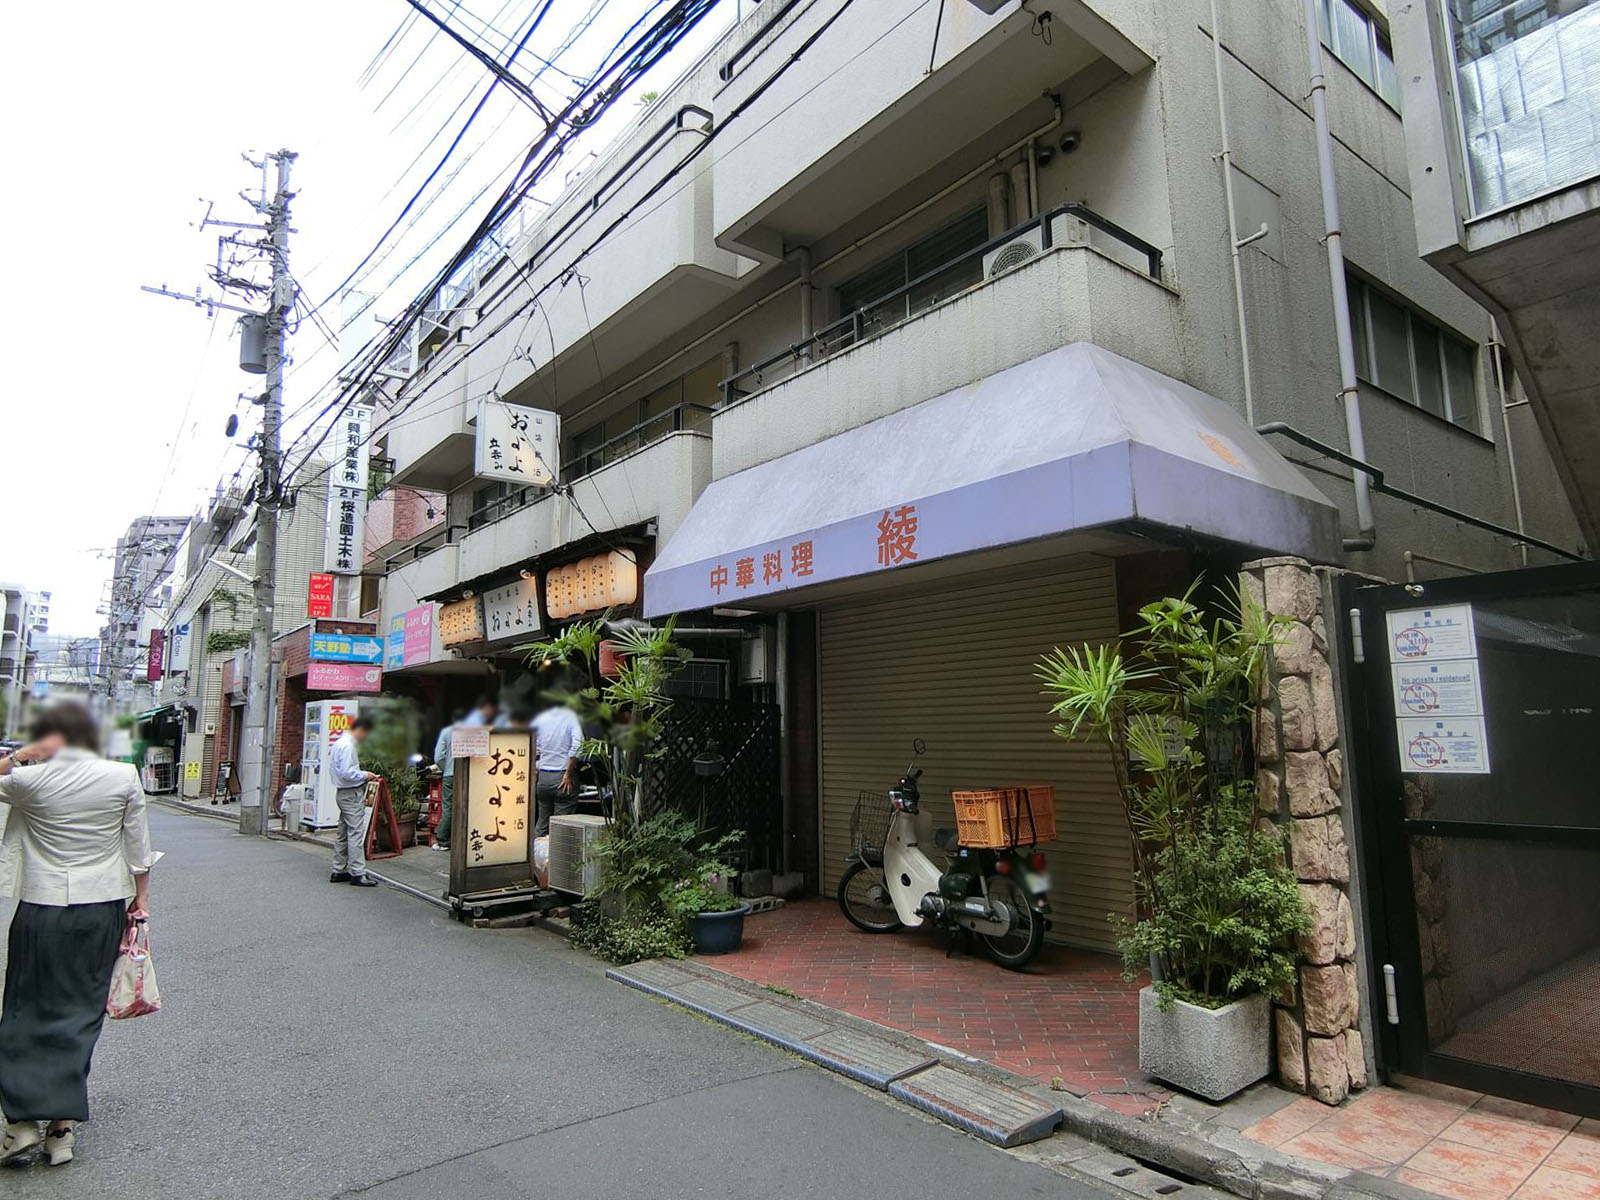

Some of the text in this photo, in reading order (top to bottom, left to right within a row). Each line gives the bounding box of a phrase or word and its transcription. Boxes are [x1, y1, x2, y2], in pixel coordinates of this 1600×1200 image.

[345, 408, 366, 418] 3F
[340, 488, 360, 499] 2F
[710, 505, 918, 595] 中華料理 綾
[470, 828, 484, 862] 立呑み
